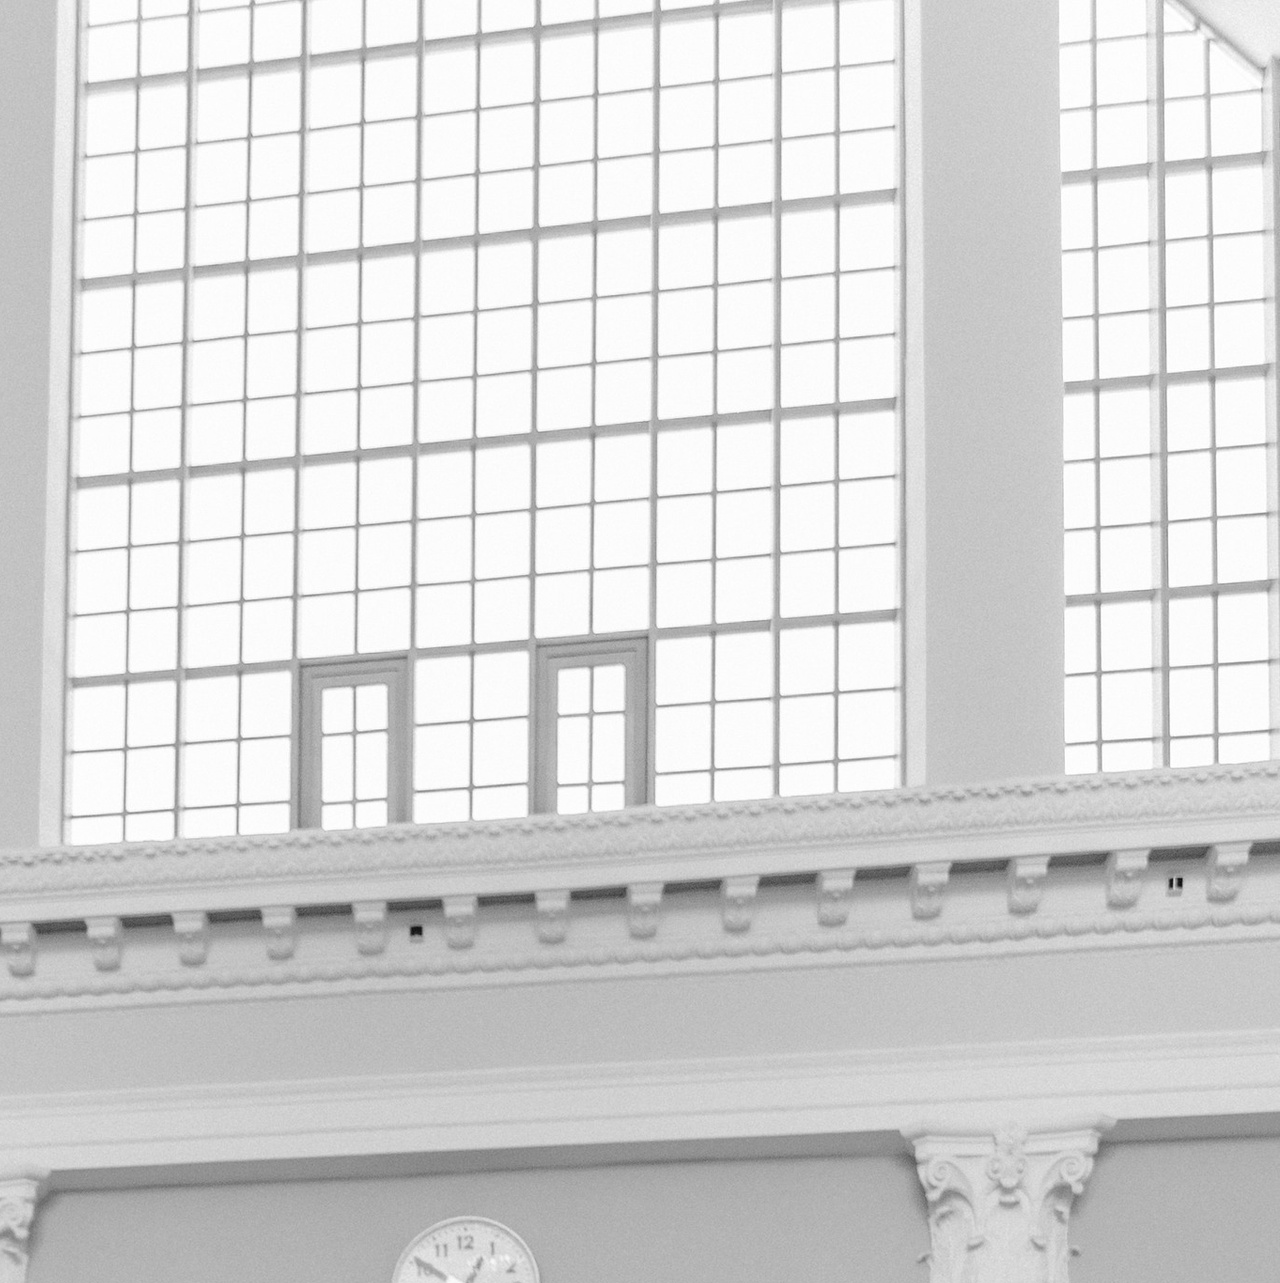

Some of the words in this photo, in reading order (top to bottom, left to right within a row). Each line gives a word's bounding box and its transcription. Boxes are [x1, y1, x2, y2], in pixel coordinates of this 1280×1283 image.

[457, 1235, 474, 1250] 12
[489, 1241, 495, 1256] 1
[435, 1244, 449, 1257] 11
